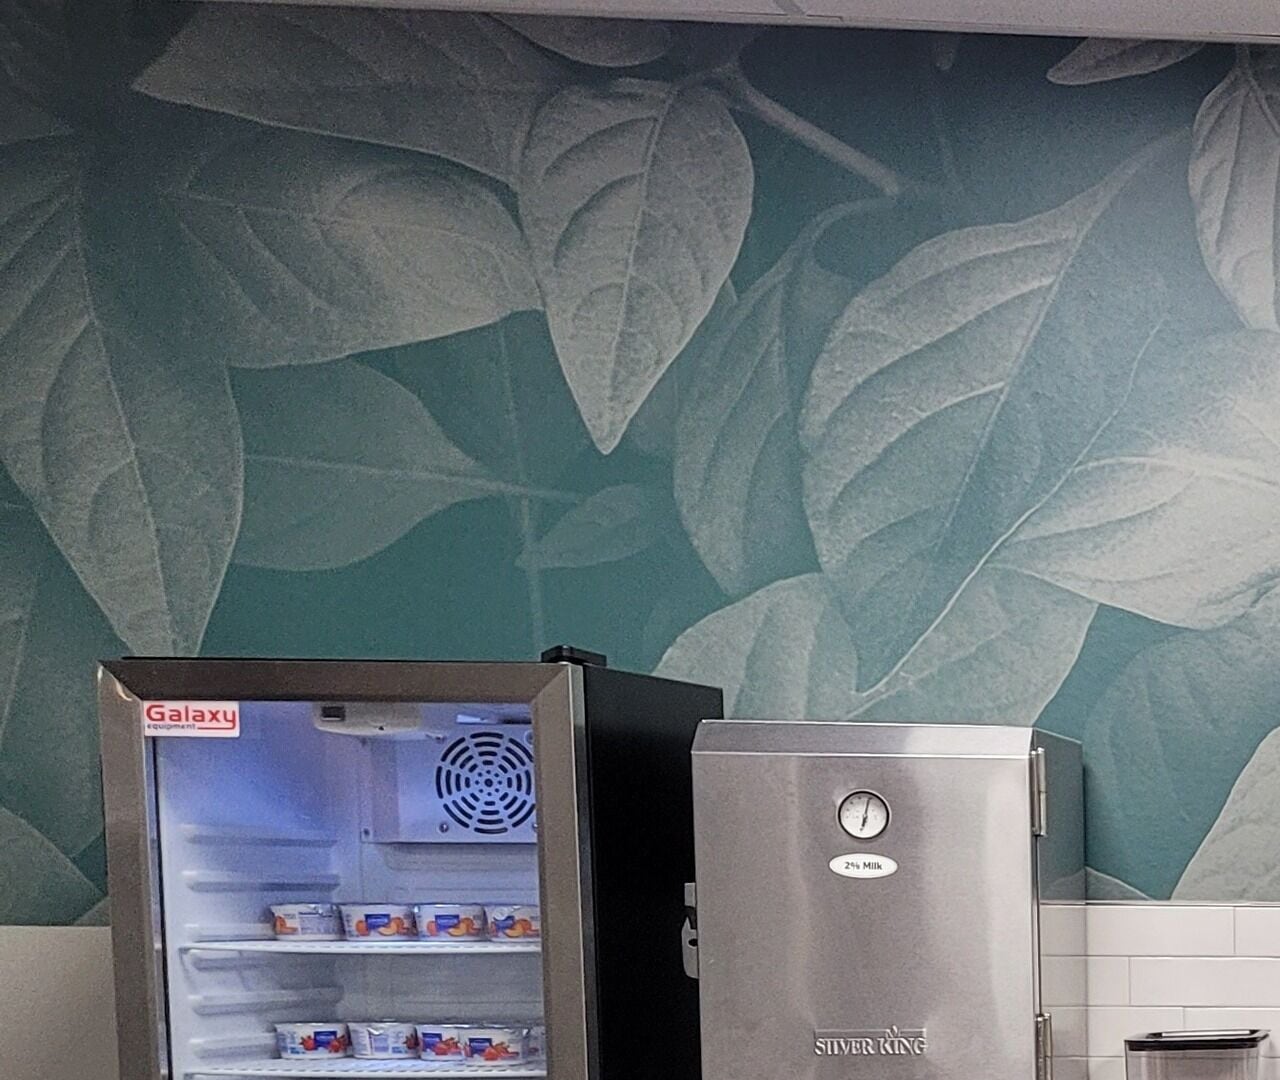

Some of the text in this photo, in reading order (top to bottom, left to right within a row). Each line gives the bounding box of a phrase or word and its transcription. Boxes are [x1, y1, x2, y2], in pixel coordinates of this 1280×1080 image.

[146, 704, 236, 730] Galaxy
[147, 723, 196, 731] equipment
[844, 861, 882, 871] 2% Milk
[814, 1037, 928, 1055] SILVER KING
